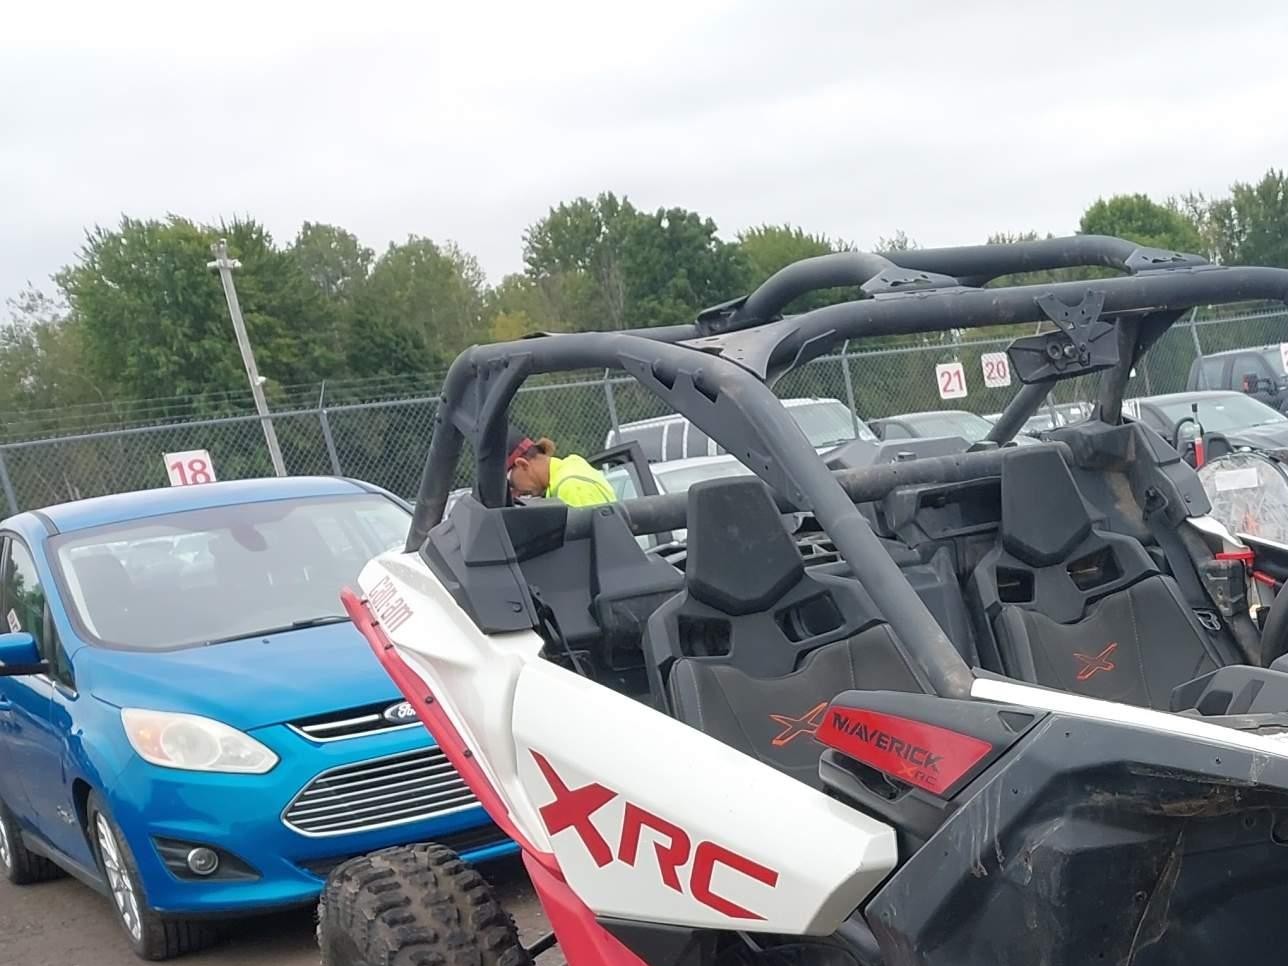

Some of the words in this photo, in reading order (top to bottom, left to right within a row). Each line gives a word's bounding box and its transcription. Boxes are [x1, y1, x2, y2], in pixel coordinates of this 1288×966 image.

[940, 369, 964, 393] 21
[985, 361, 1007, 381] 20
[170, 459, 212, 487] 18
[832, 712, 945, 774] MAVERICK
[528, 747, 779, 921] XRC
